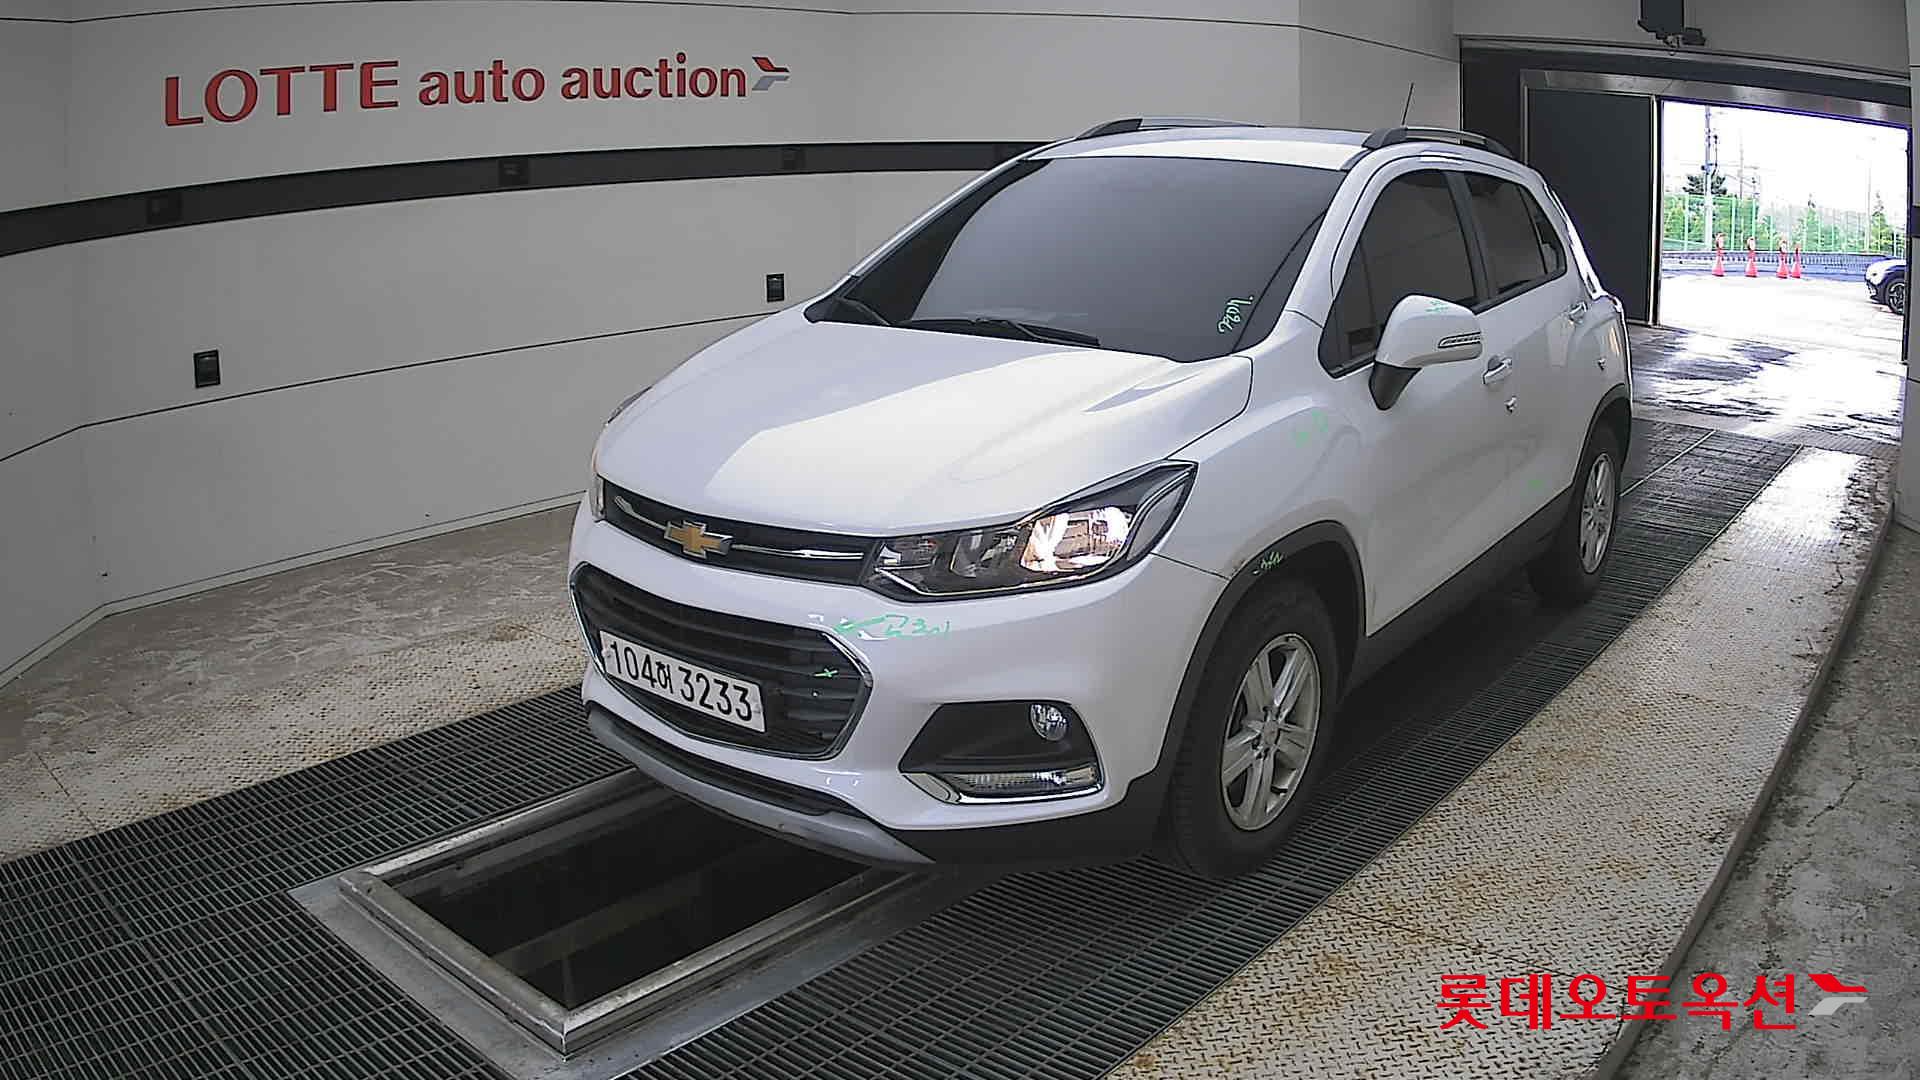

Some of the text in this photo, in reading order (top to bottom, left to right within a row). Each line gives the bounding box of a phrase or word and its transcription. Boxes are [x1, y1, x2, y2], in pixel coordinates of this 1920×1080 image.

[164, 52, 747, 127] LOTTE auto auction
[677, 665, 754, 723] 3233
